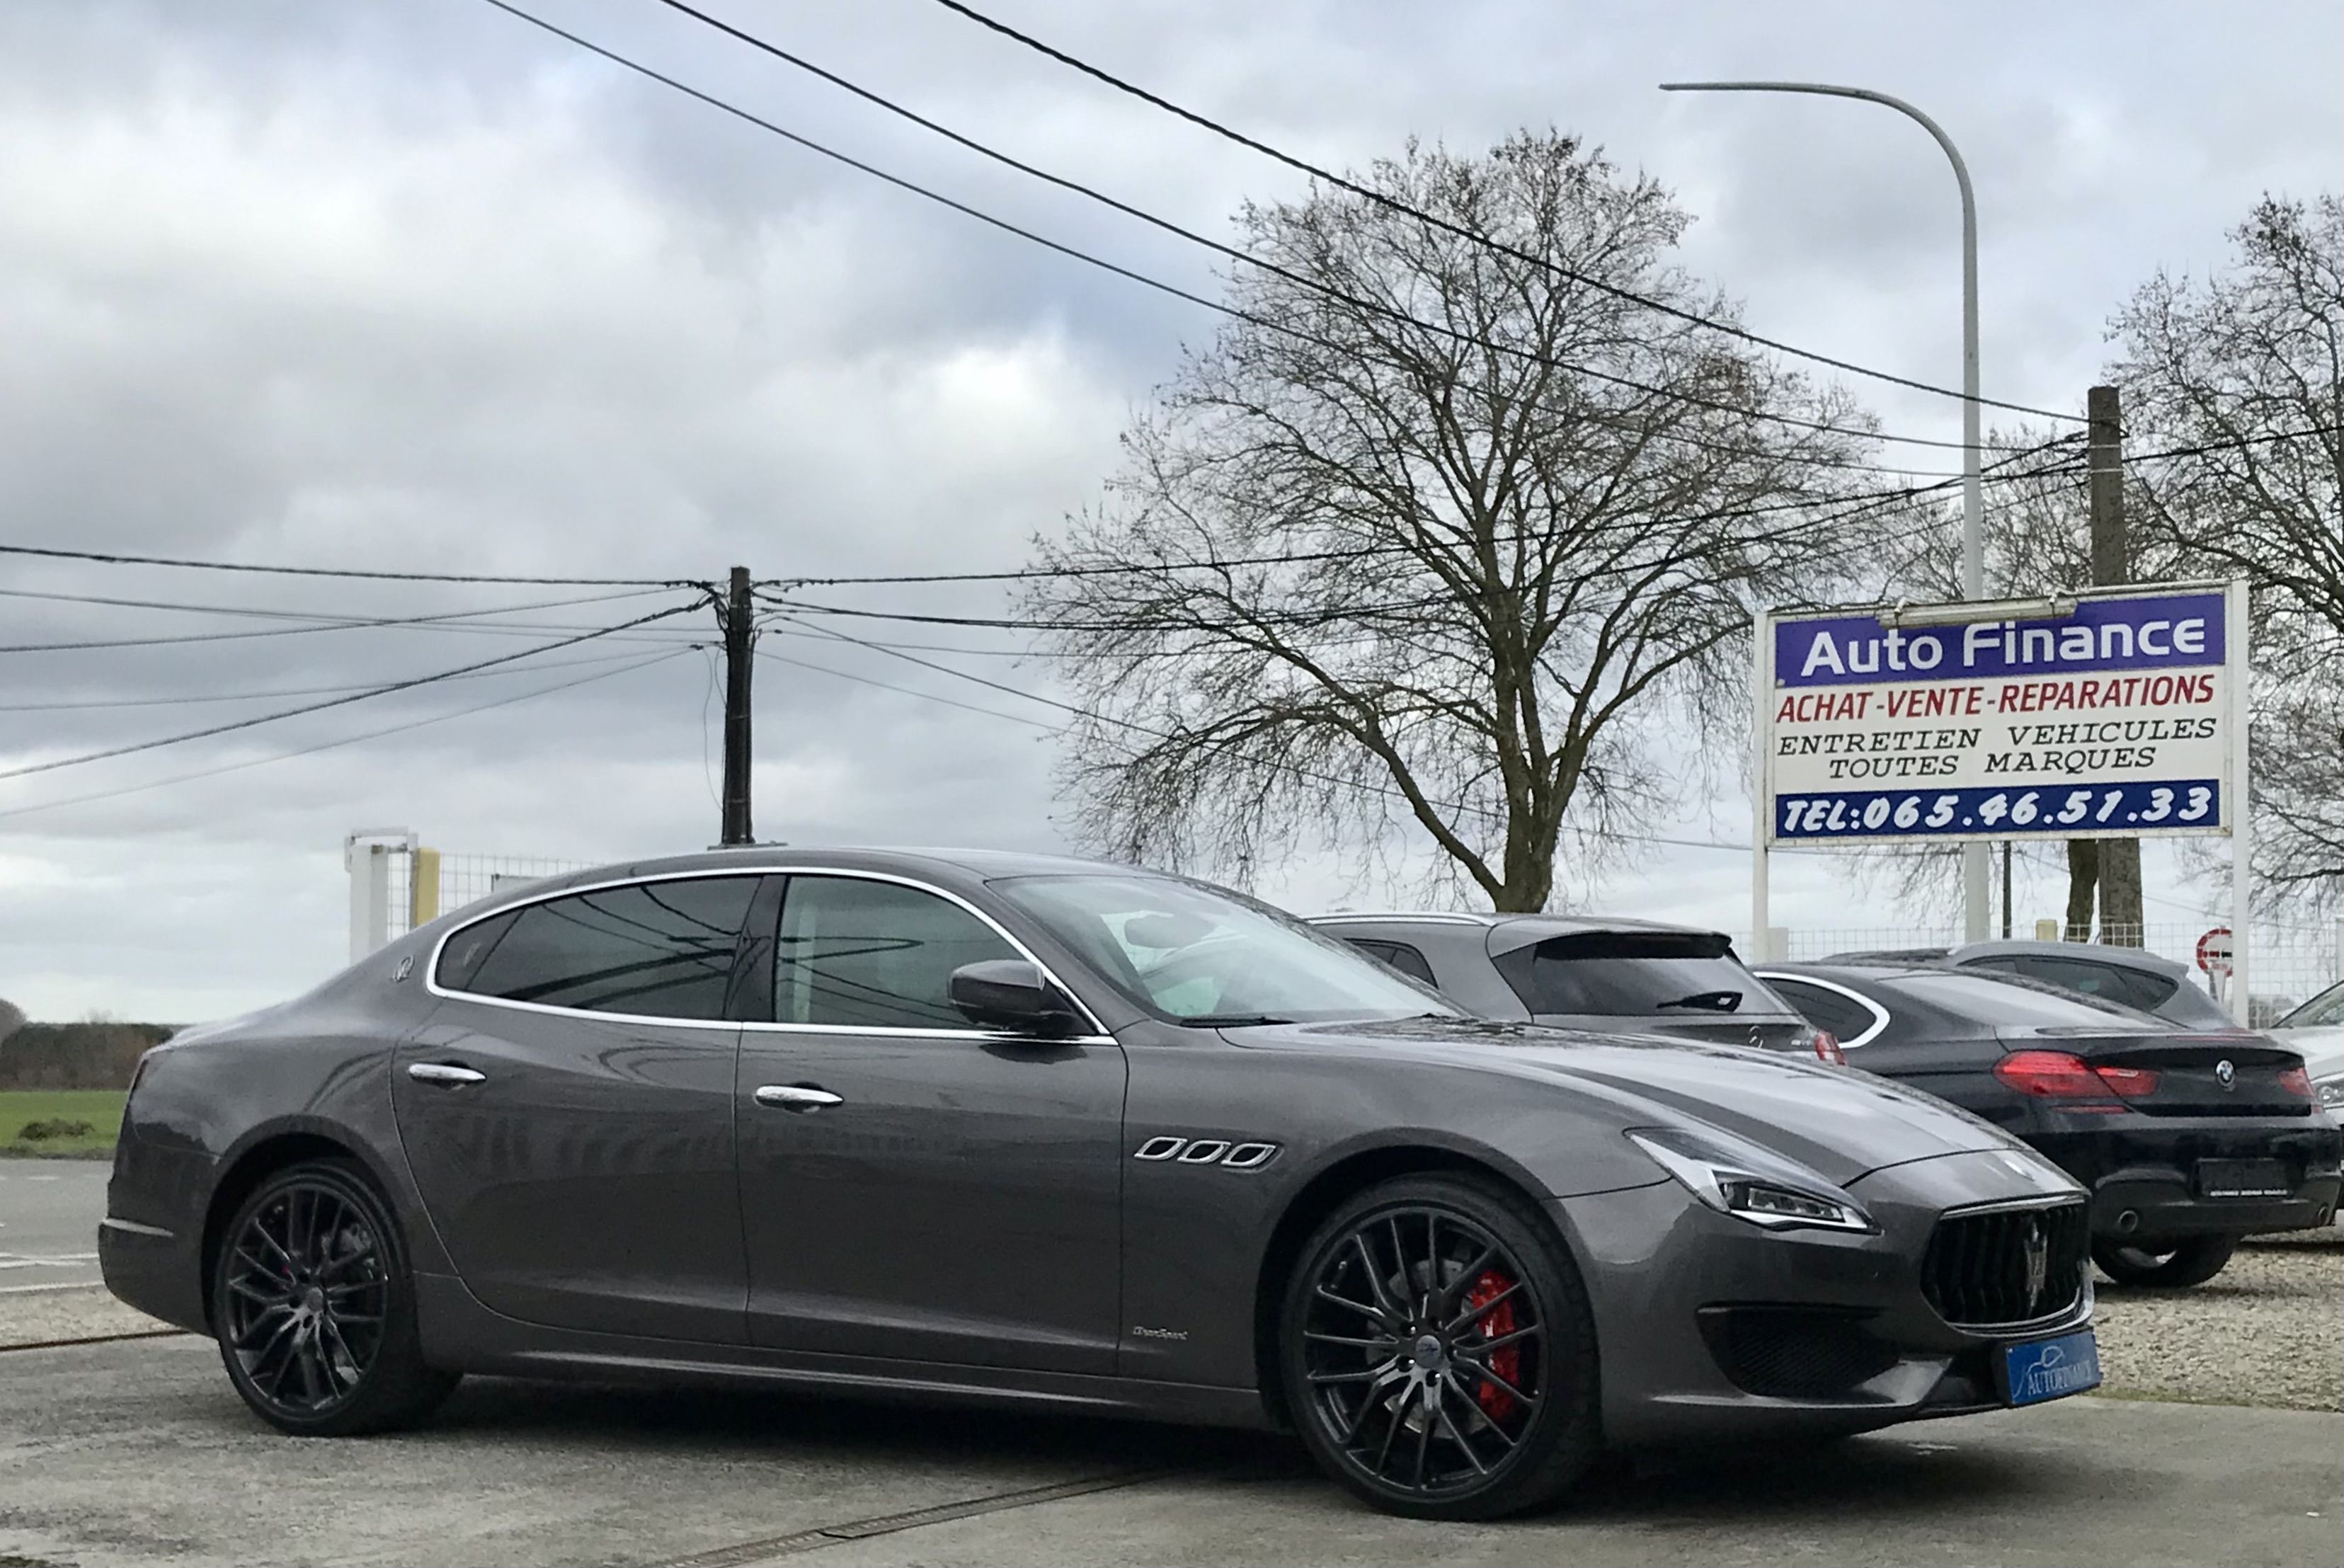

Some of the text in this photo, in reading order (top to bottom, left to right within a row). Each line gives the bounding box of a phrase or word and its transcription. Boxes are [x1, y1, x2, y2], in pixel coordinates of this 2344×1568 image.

[1800, 618, 2205, 677] Auto Finance
[1777, 718, 2217, 756] ENTRETIEN VEHICULES
[1829, 747, 2156, 779] TOUTES MARQUES
